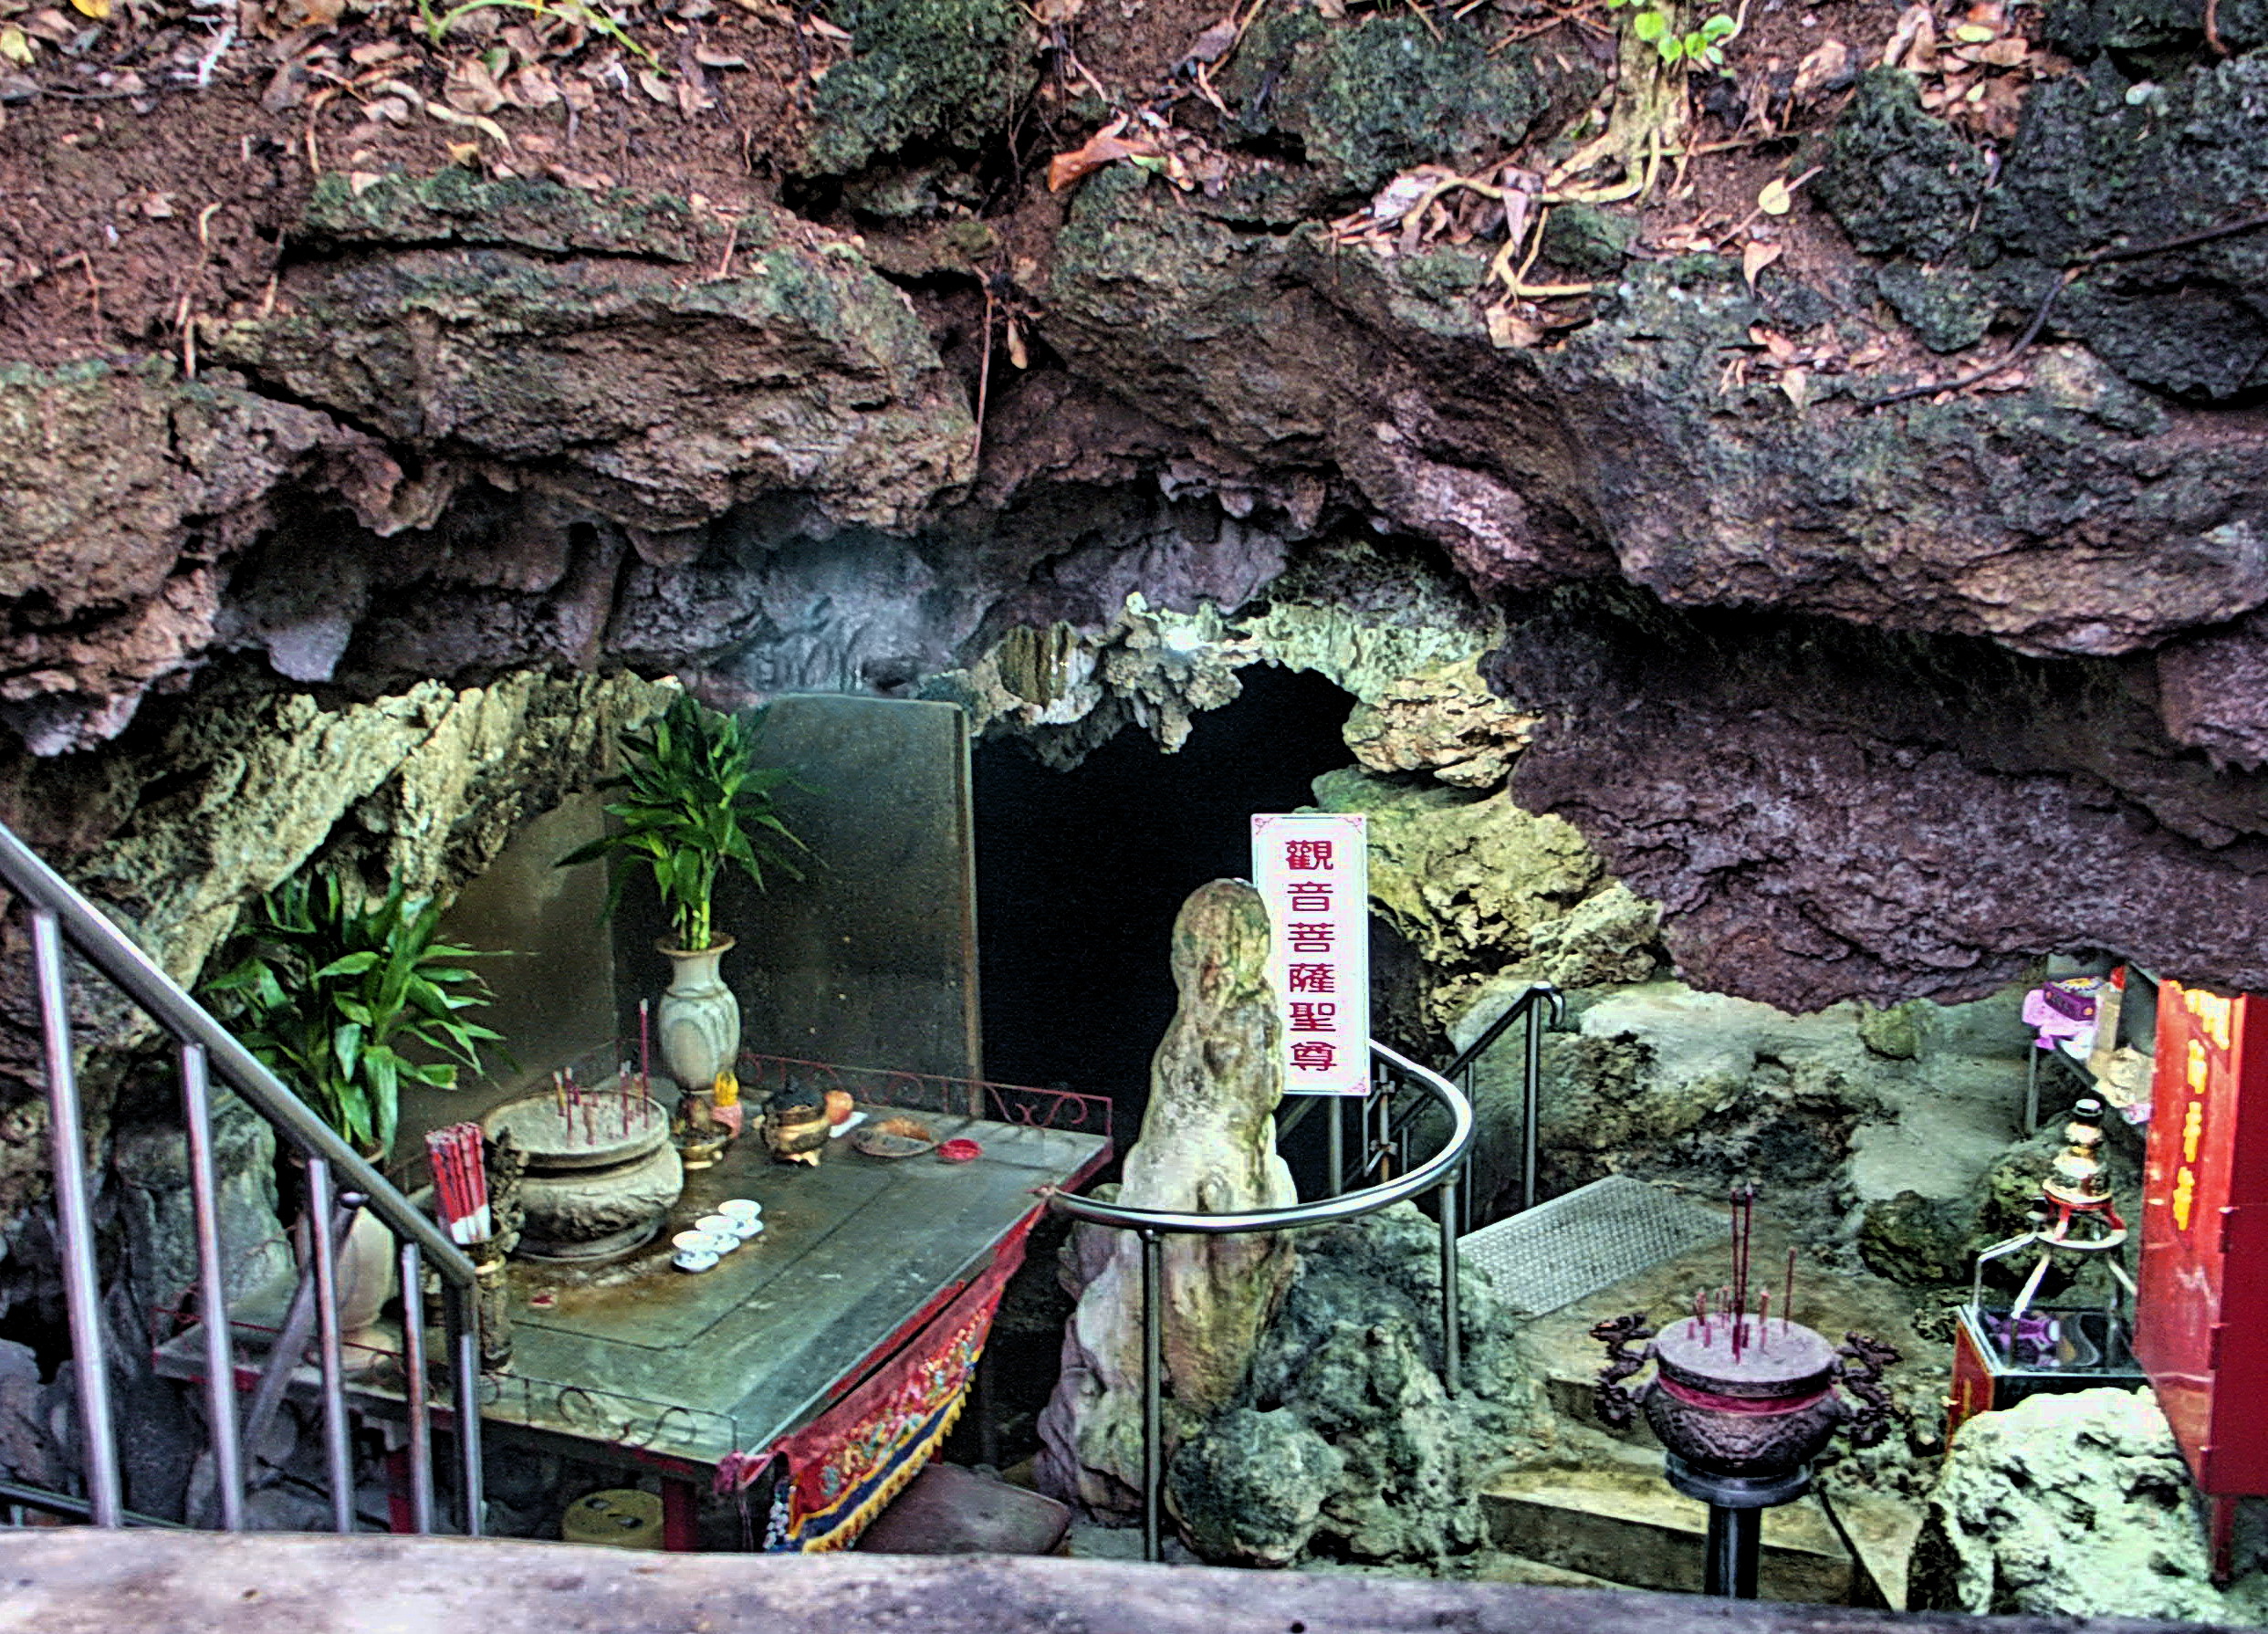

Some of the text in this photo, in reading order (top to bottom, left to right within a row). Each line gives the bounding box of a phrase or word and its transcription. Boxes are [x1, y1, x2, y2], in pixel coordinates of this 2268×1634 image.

[1285, 840, 1337, 1072] 觀音菩薩聖尊
